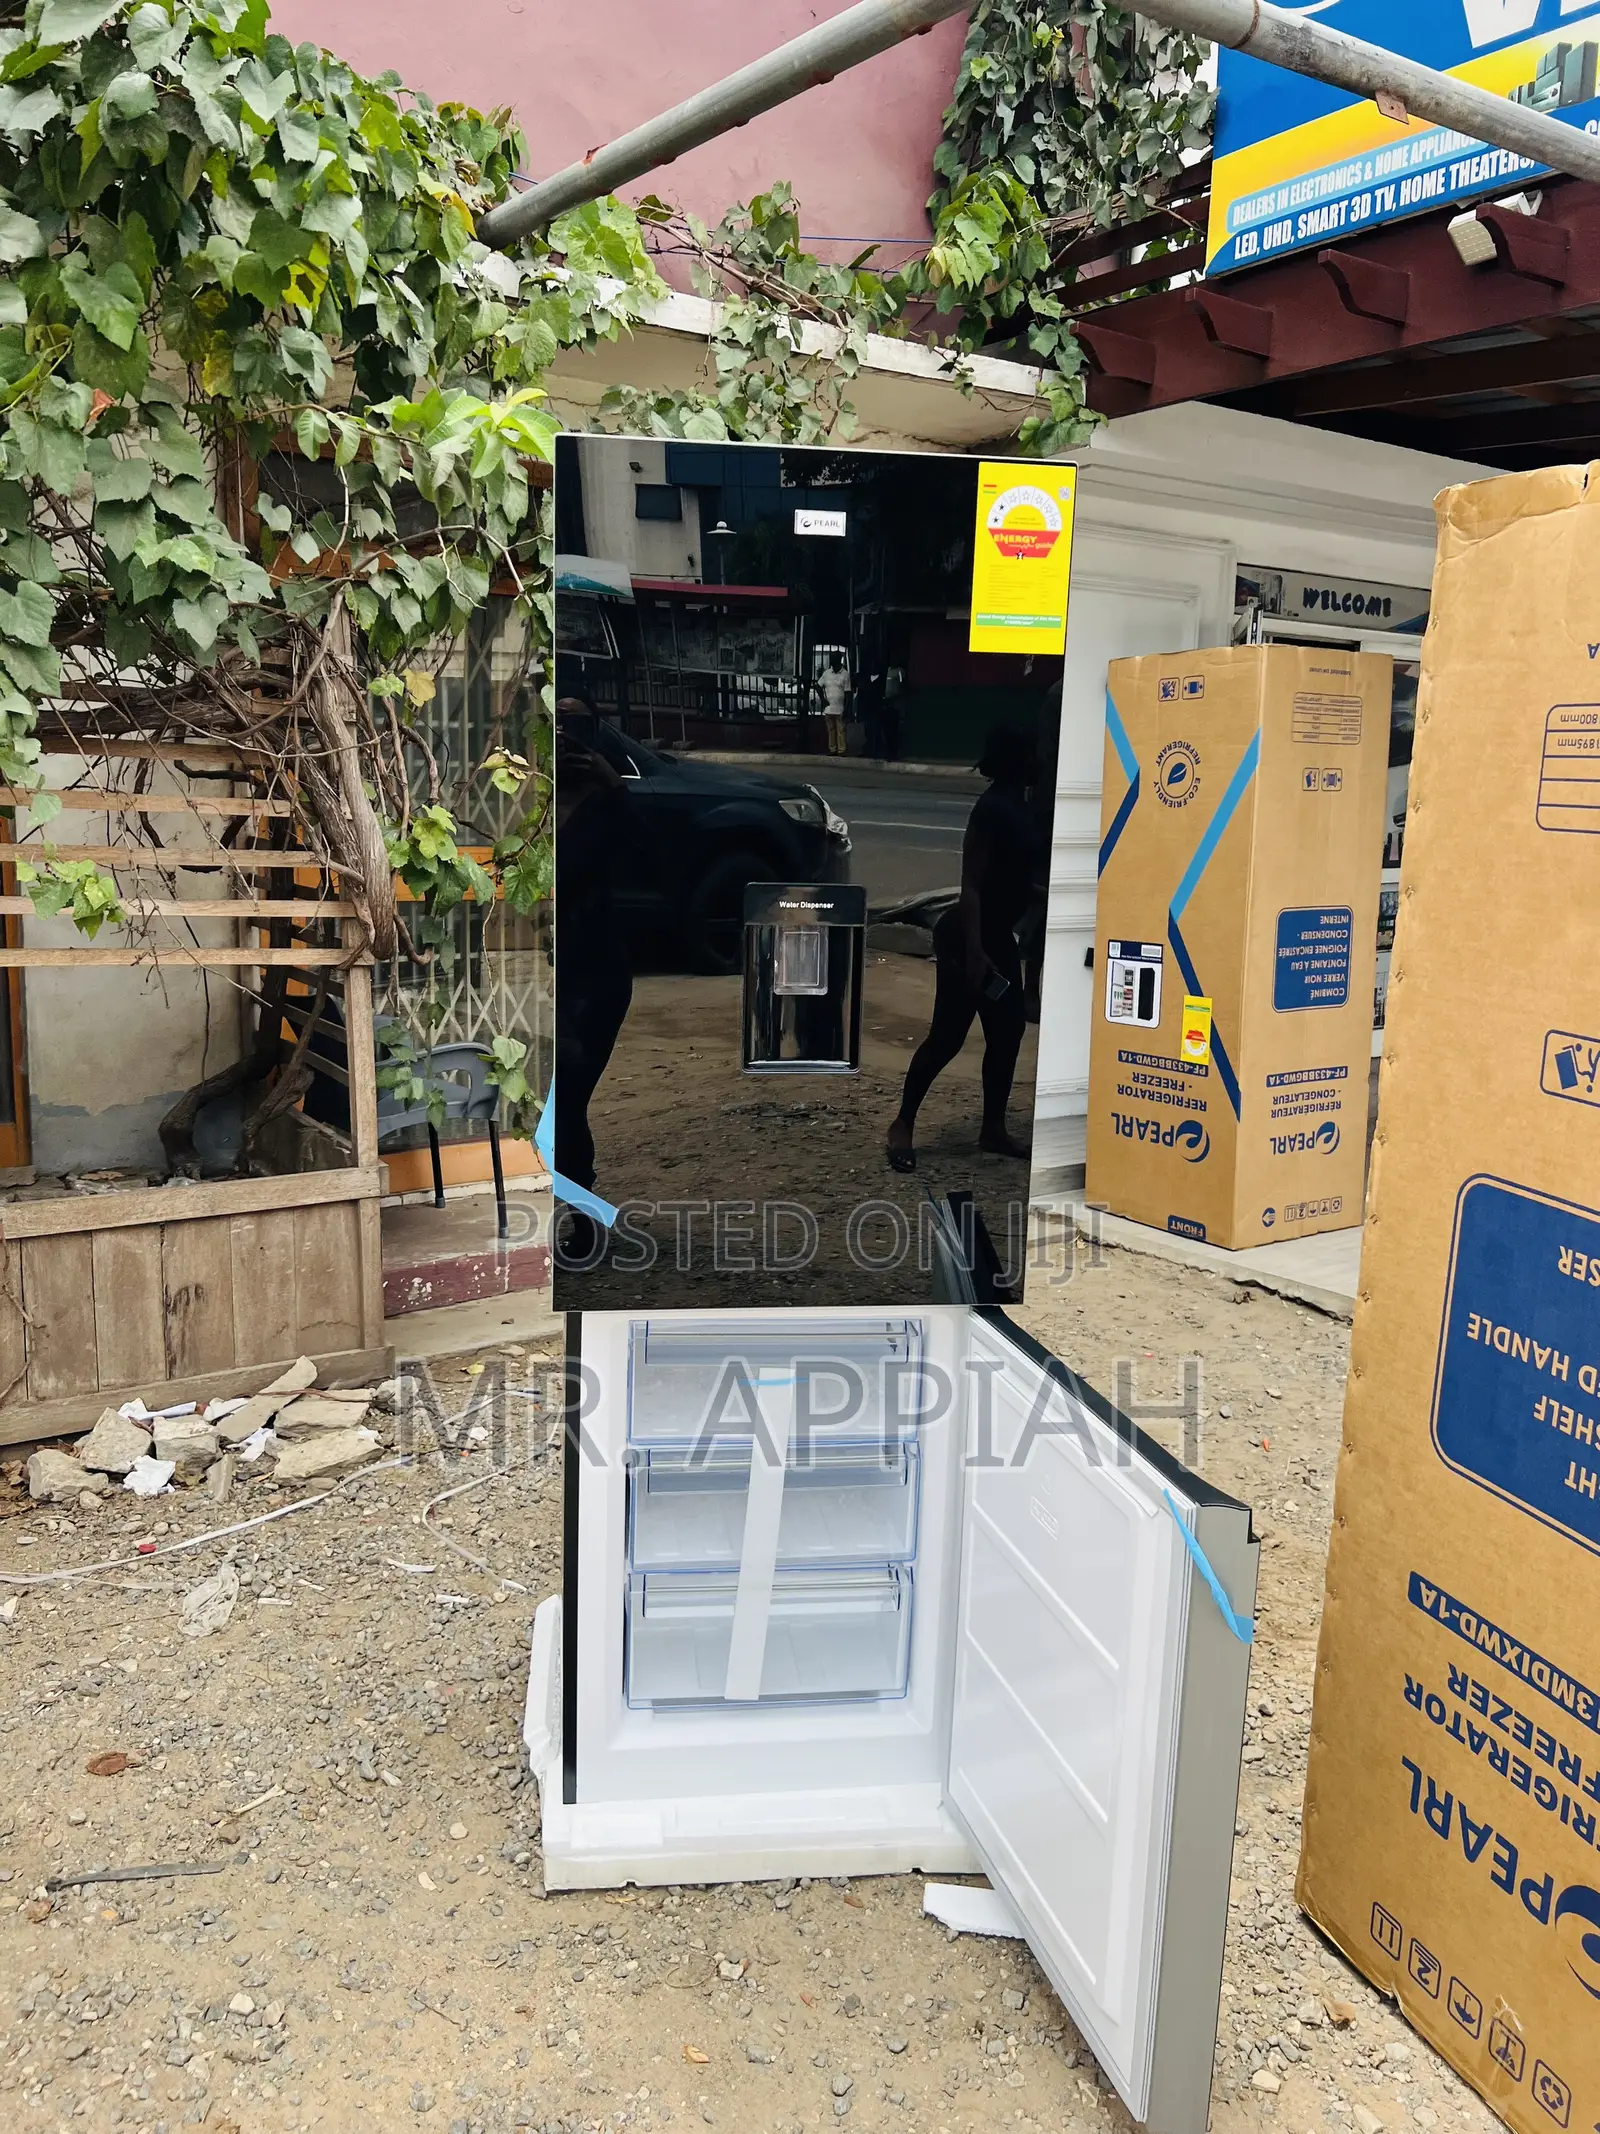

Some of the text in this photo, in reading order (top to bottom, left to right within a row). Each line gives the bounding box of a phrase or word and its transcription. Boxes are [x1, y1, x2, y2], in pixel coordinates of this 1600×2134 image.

[1232, 192, 1275, 226] DEALERS
[1277, 187, 1289, 211] IN
[1290, 161, 1362, 206] ELECTRONICS
[1364, 161, 1373, 181] &
[1375, 145, 1410, 177] HOME
[1234, 231, 1260, 260] LED,
[1297, 200, 1349, 239] SMART
[1350, 192, 1371, 222] 3D
[1375, 184, 1397, 214] TV,
[1400, 167, 1446, 206] HOME
[1303, 587, 1392, 618] WELCOME
[1560, 713, 1600, 725] 800mm
[1155, 741, 1201, 767] REFRIGERANT
[1153, 777, 1201, 809] ECO-FRIENDLY
[779, 901, 834, 910] Water Dispenser
[1320, 915, 1349, 925] INTERNE
[1291, 961, 1303, 971] EAU
[1311, 958, 1347, 969] FONTAINE
[1304, 973, 1345, 984] VERRE NOIR
[1121, 1051, 1206, 1075] PF-433BBGWD-1A
[1132, 1072, 1185, 1092] FREEZER
[1268, 1067, 1346, 1086] PF-433BBGWD-1A
[1117, 1084, 1207, 1112] REFRIGERATOR
[1110, 1112, 1175, 1148] PEARL
[1269, 1131, 1315, 1155] PEARL
[1170, 1220, 1203, 1237] FRONT
[1466, 1312, 1600, 1398] D HANDLE
[1564, 1460, 1600, 1500] HT
[1419, 1581, 1600, 1730] 3MDIXWD-1A
[1403, 1672, 1600, 1852] RIGERATOR
[1401, 1755, 1554, 1926] PEARL
